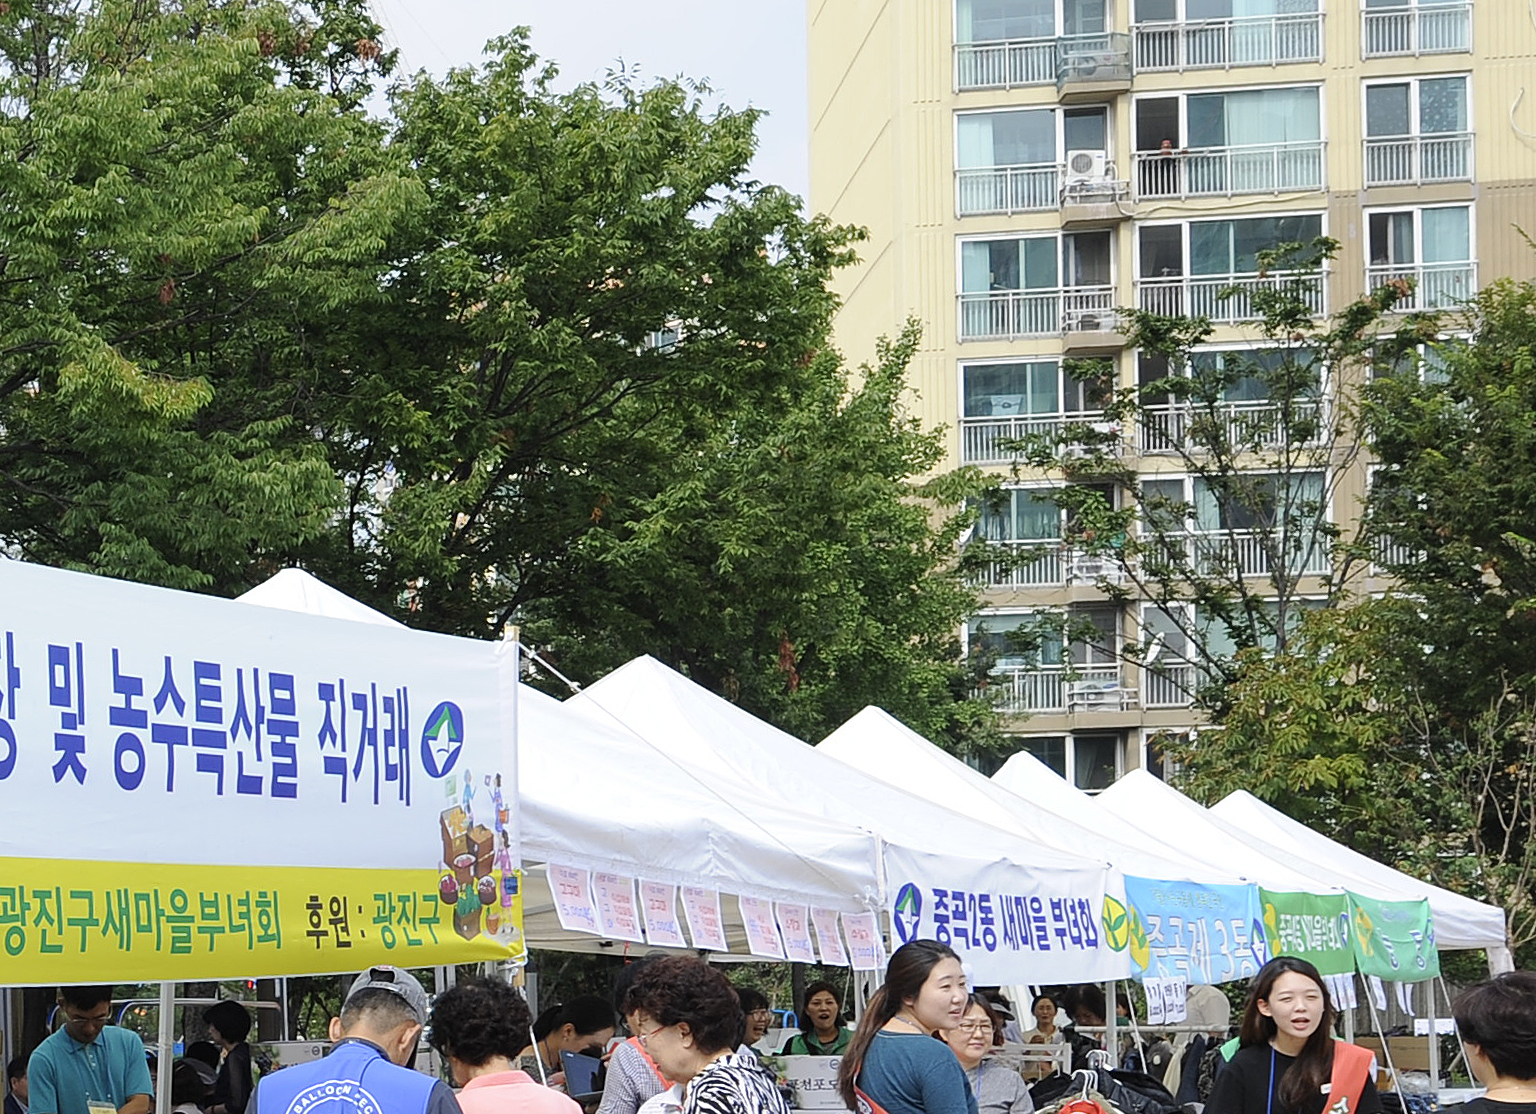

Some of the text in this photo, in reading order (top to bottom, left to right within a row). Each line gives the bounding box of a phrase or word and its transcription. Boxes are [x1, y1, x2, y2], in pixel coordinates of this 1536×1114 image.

[47, 641, 88, 786] 및
[109, 647, 300, 799] 농수특산물
[317, 677, 412, 807] 직거래
[371, 891, 442, 948] 광진구
[931, 887, 997, 952] 중곡2동
[999, 894, 1051, 951] 새마을
[1049, 897, 1098, 951] 부녀회
